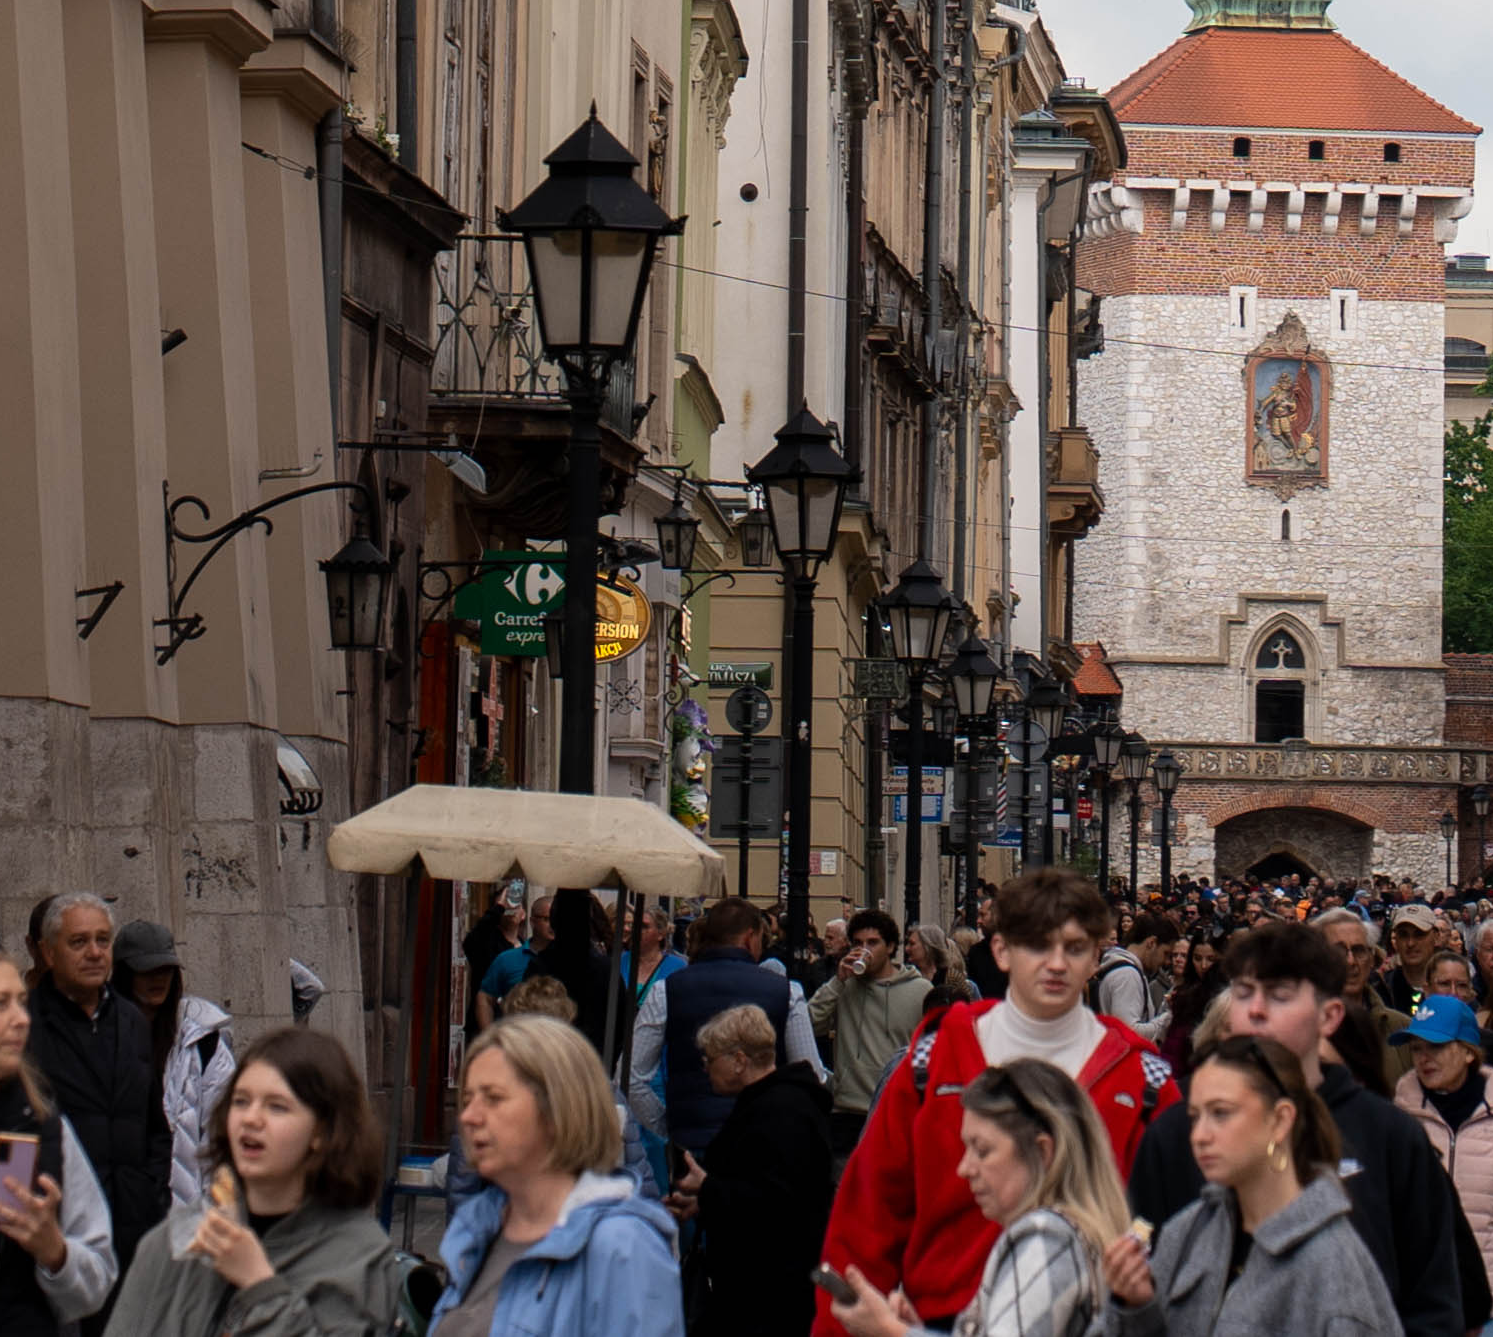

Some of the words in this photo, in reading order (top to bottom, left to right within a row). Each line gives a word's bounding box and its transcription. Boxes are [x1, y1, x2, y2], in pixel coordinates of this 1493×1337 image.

[494, 611, 547, 626] Carref
[505, 629, 546, 647] expre
[595, 622, 640, 640] ERSION
[595, 642, 622, 659] AKCJI
